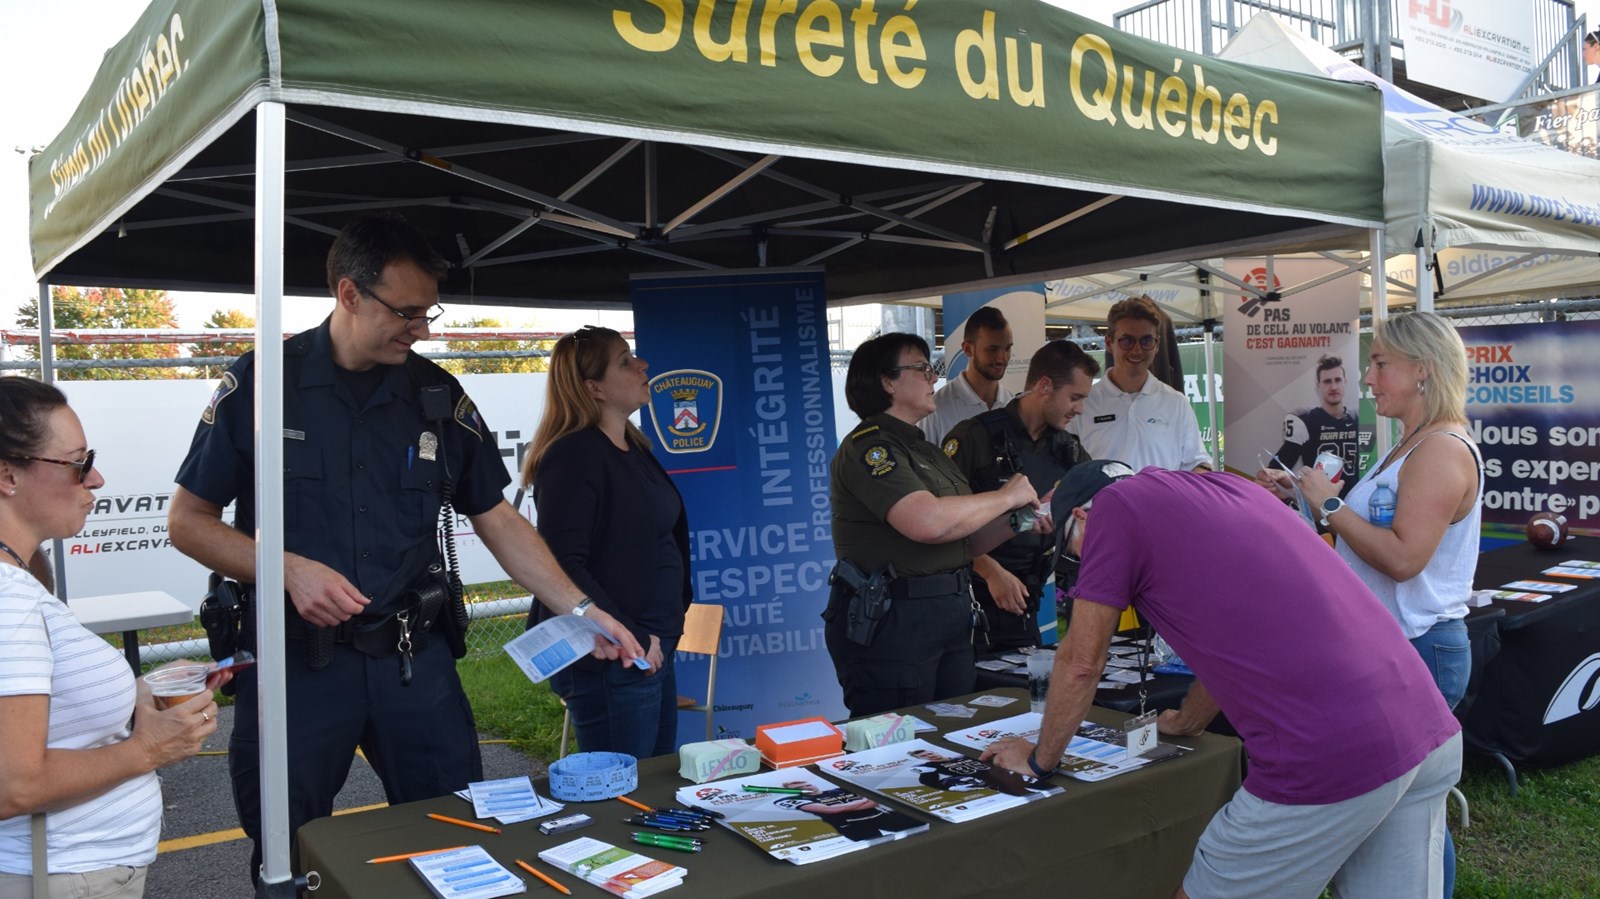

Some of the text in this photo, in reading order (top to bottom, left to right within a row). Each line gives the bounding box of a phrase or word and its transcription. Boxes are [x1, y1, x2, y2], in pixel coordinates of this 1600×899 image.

[954, 9, 1046, 108] du
[1069, 33, 1279, 156] Québec
[1533, 112, 1572, 133] Fier
[1264, 308, 1290, 322] PAS
[1247, 322, 1352, 336] DE CELL AU VOLANT,
[1246, 336, 1331, 349] C'EST GAGNANT!
[1464, 345, 1513, 364] PRIX
[1468, 365, 1531, 384] CHOIX
[654, 376, 715, 393] CHÂTEAUGUAY
[1465, 385, 1575, 404] CONSEILS
[740, 305, 794, 507] INTÉGRITÉ
[795, 287, 832, 542] PROFESSIONNALISME
[1467, 419, 1538, 445] Nous
[673, 436, 705, 448] POLICE
[90, 495, 170, 515] AVAT
[1480, 487, 1576, 513] ontre»
[70, 525, 149, 539] LEYFIELD,
[688, 522, 810, 562] RVICE
[693, 559, 838, 602] ESPEC
[722, 596, 785, 628] AUTÉ
[713, 703, 754, 713] Châteauguay
